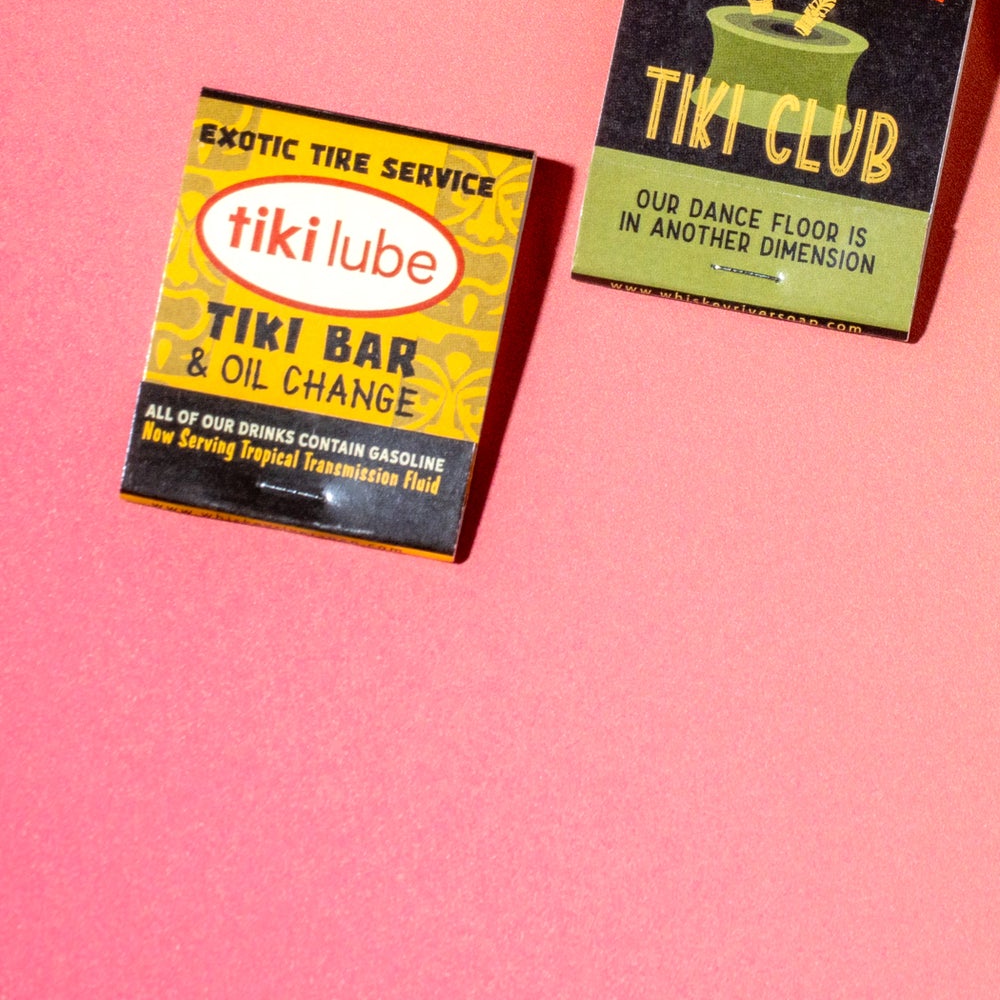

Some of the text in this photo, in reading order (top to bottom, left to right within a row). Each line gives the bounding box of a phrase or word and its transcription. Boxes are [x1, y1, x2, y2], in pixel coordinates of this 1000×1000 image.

[199, 123, 496, 198] EXOTIC TIRE SERVICE
[646, 65, 899, 184] TIKI CLUB
[228, 206, 437, 285] tiki lube
[619, 211, 875, 275] IN ANOTHER DIMENSION
[637, 189, 867, 248] OUR DANCE FLOOR IS
[207, 301, 418, 378] TIKI BAR
[187, 347, 418, 418] & OIL CHANGE
[141, 421, 441, 495] Now Serving Tropical Transmission Fluid
[145, 404, 446, 472] ALL OF OUR DRINKS CONTAIN GASOLINE
